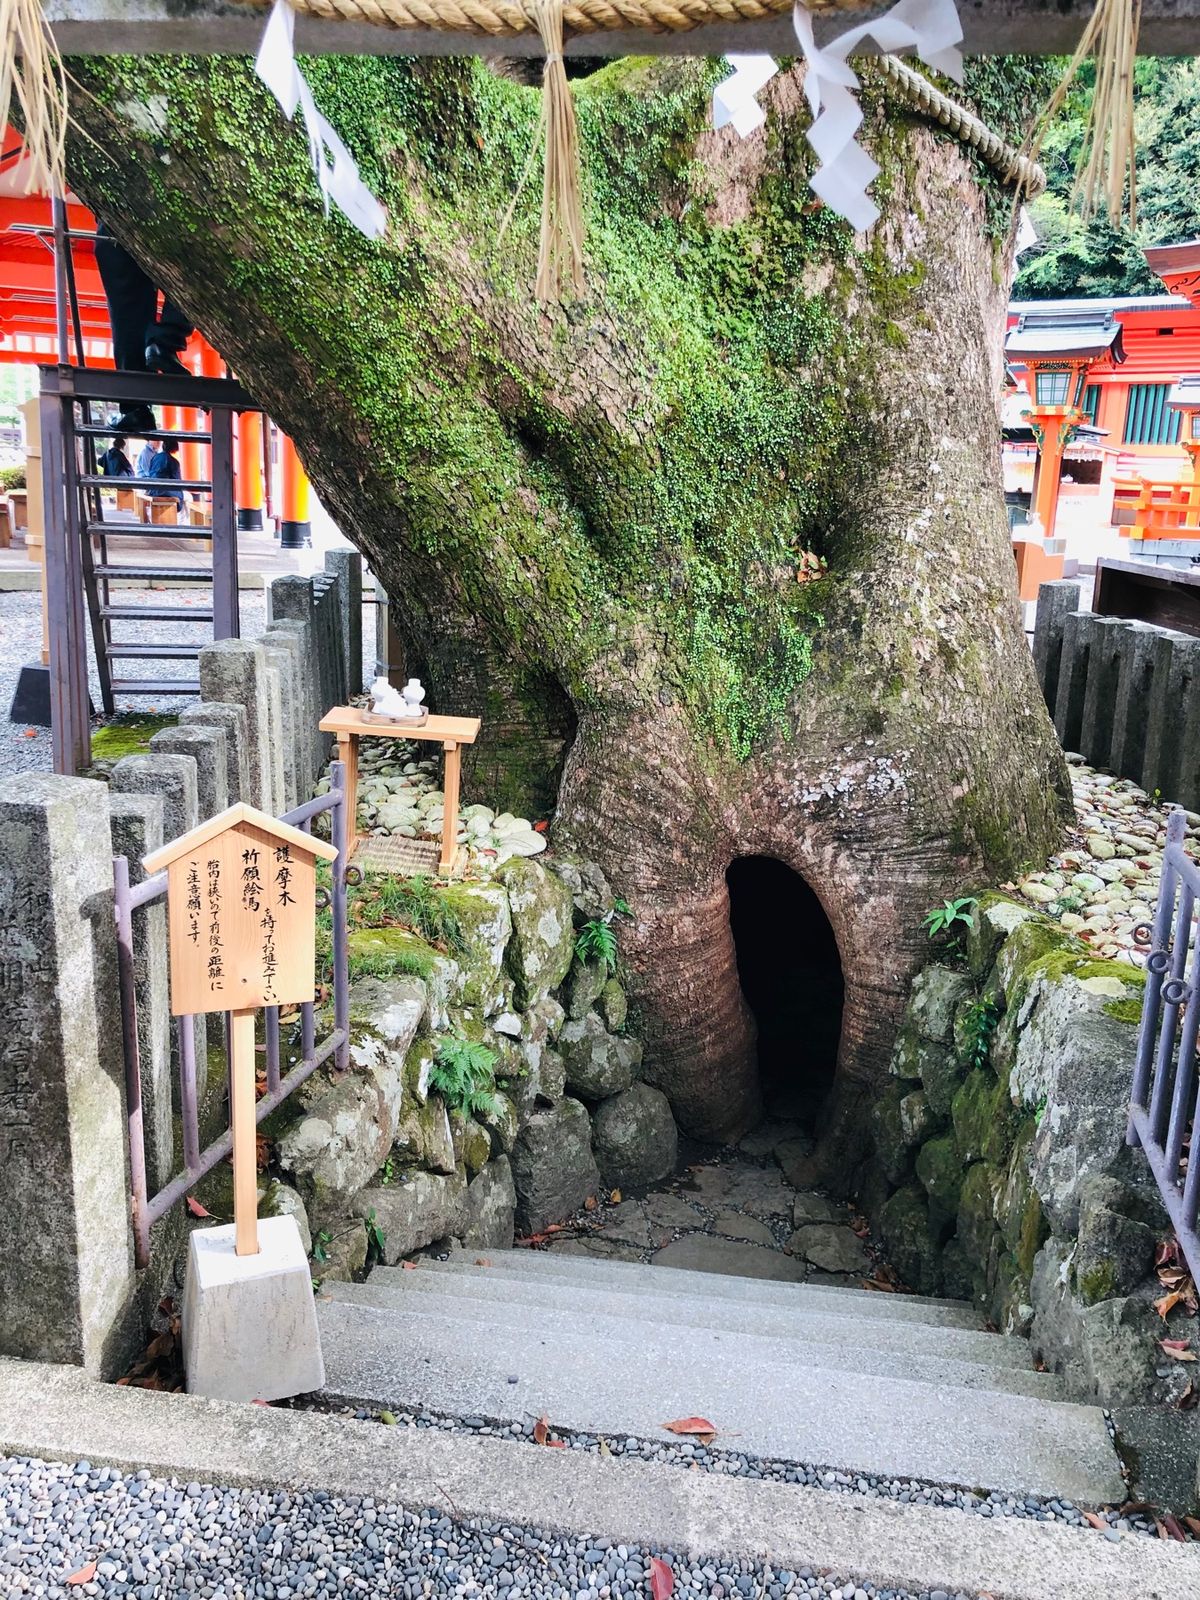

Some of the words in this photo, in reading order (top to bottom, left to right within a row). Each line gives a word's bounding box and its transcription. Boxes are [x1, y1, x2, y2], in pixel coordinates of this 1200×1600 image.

[241, 848, 264, 912] 祈願絵馬
[273, 845, 296, 907] 護摩木
[207, 859, 225, 991] 胎内は狭いので前後の距離に
